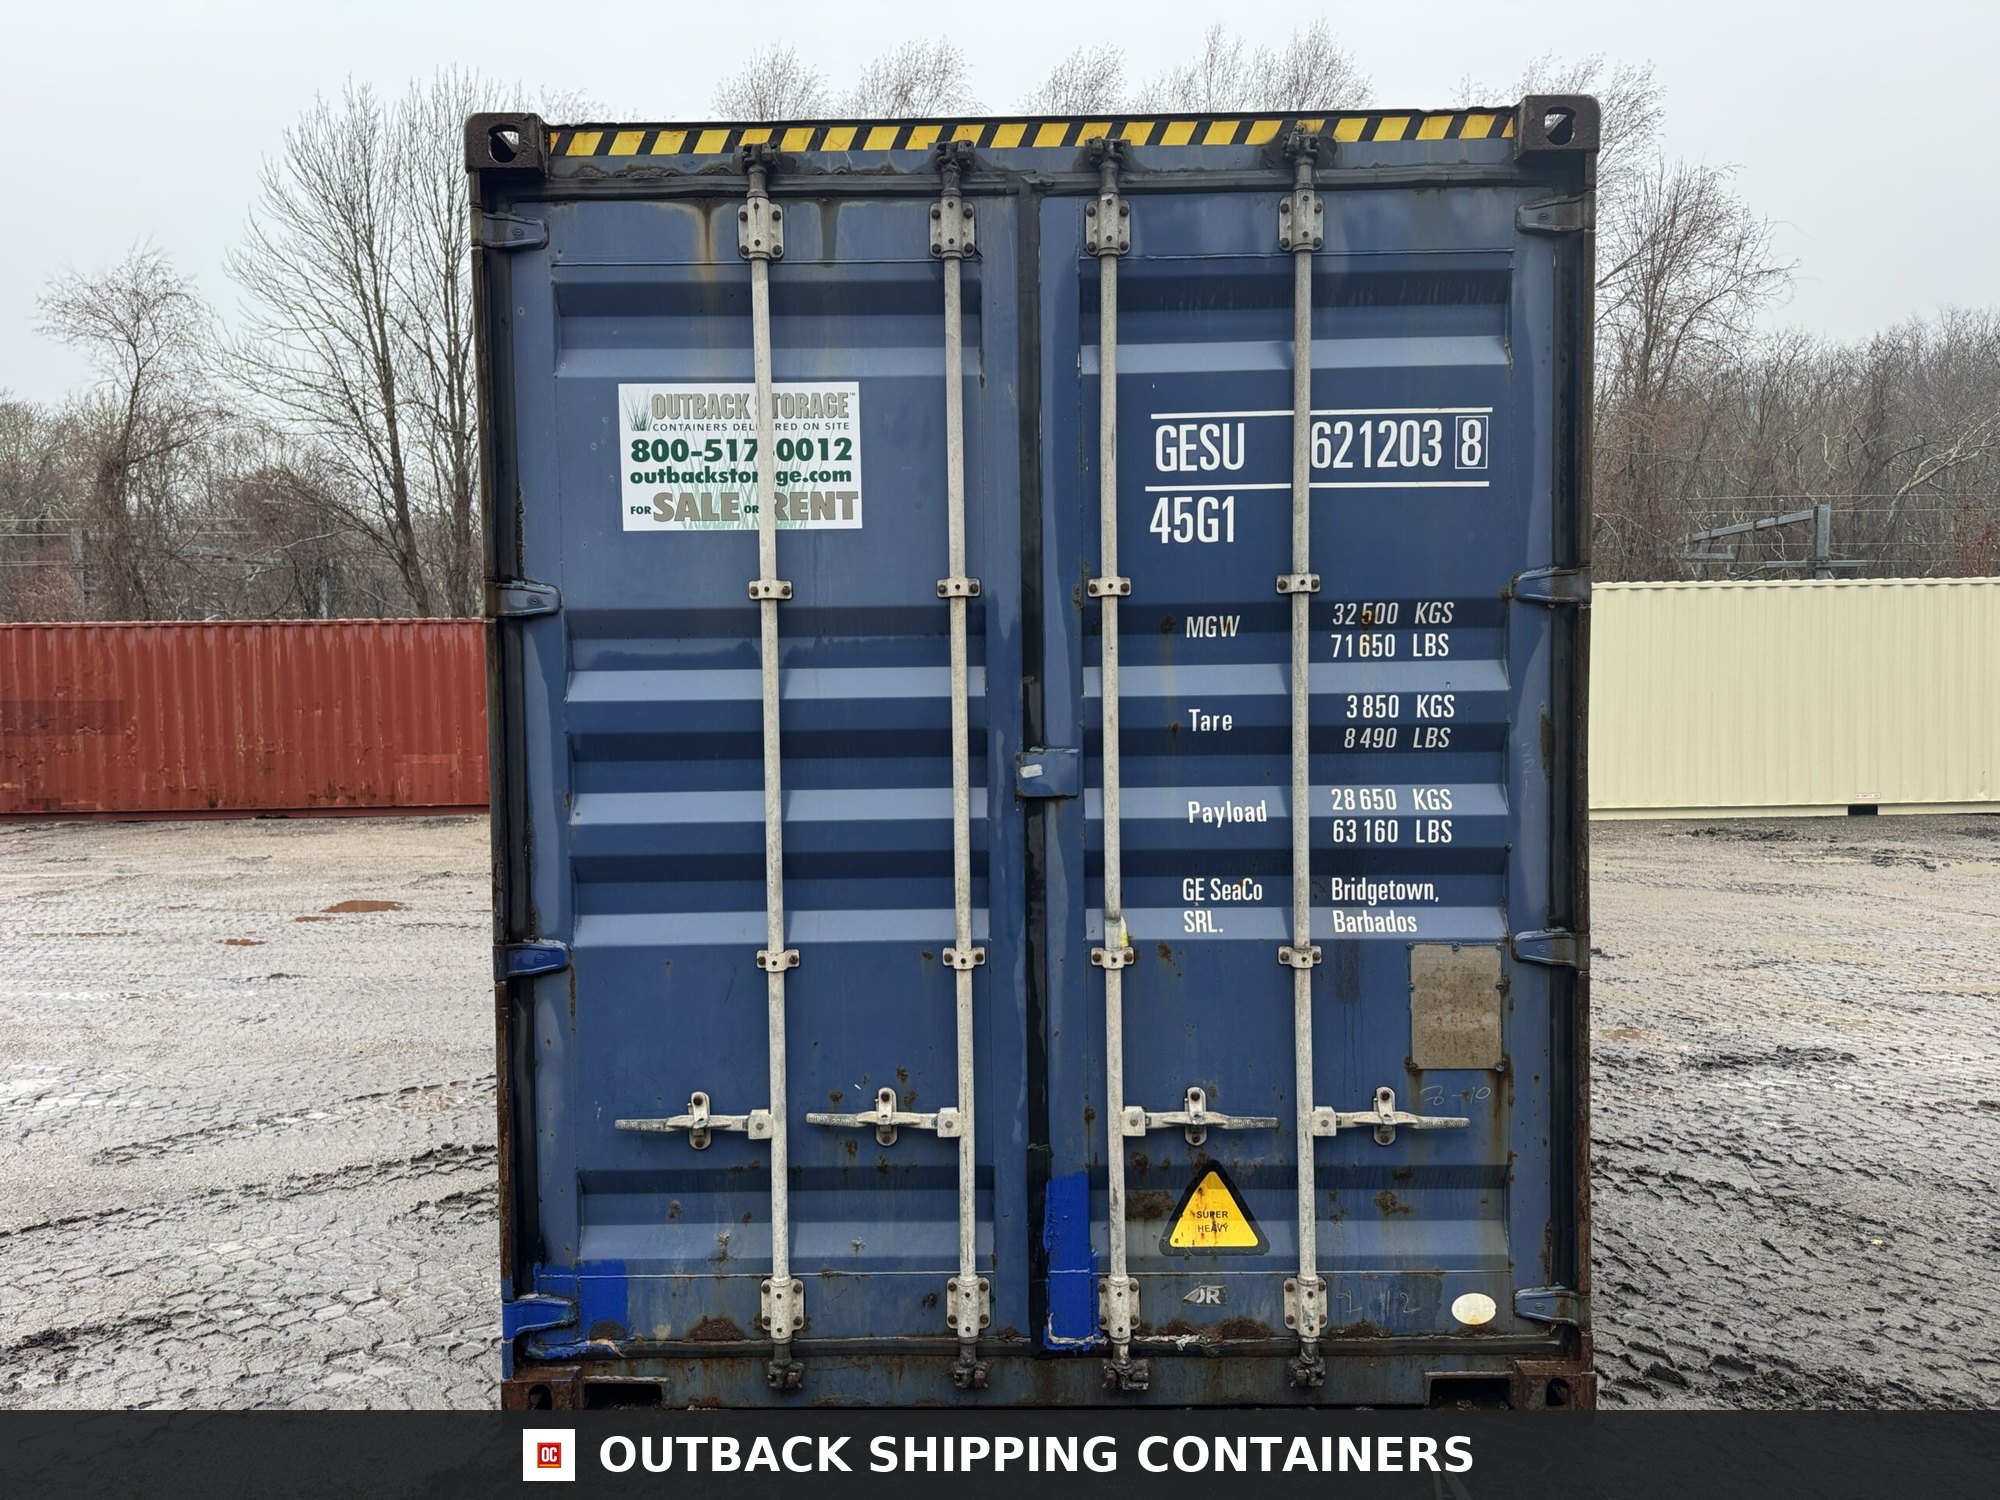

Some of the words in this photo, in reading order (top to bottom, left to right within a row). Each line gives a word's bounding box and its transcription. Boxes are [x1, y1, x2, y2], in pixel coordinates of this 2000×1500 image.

[651, 392, 751, 420] OUTBACK
[755, 391, 849, 420] TORAGE
[653, 423, 728, 431] CONTAINERS
[803, 422, 820, 431] ON
[825, 422, 850, 431] SITE
[630, 437, 853, 462] 800-5170012
[1155, 422, 1246, 472] GESU
[1311, 419, 1443, 469] 621203
[1461, 419, 1482, 466] 8
[630, 465, 852, 486] outbackstorge.com
[630, 505, 652, 515] FOR
[653, 491, 740, 522] SALE
[744, 505, 760, 514] OR
[774, 491, 859, 521] RENT
[1149, 495, 1235, 544] 45G1
[1186, 615, 1241, 638] MGW
[1414, 601, 1455, 624] KGS
[1412, 633, 1449, 657] LBS
[1188, 708, 1233, 732] Tare
[1416, 694, 1455, 718] KGS
[1412, 727, 1451, 748] LBS
[1187, 799, 1268, 828] Payload
[1412, 788, 1453, 811] KGS
[1415, 819, 1453, 843] LBS
[1182, 878, 1205, 901] GE
[1210, 878, 1263, 901] SeaCo
[1331, 877, 1440, 906] Bridgetown,
[1184, 910, 1224, 933] SRL.
[1332, 909, 1418, 933] Barbados
[1196, 1210, 1229, 1219] SUPER
[1197, 1223, 1229, 1233] HEAVY
